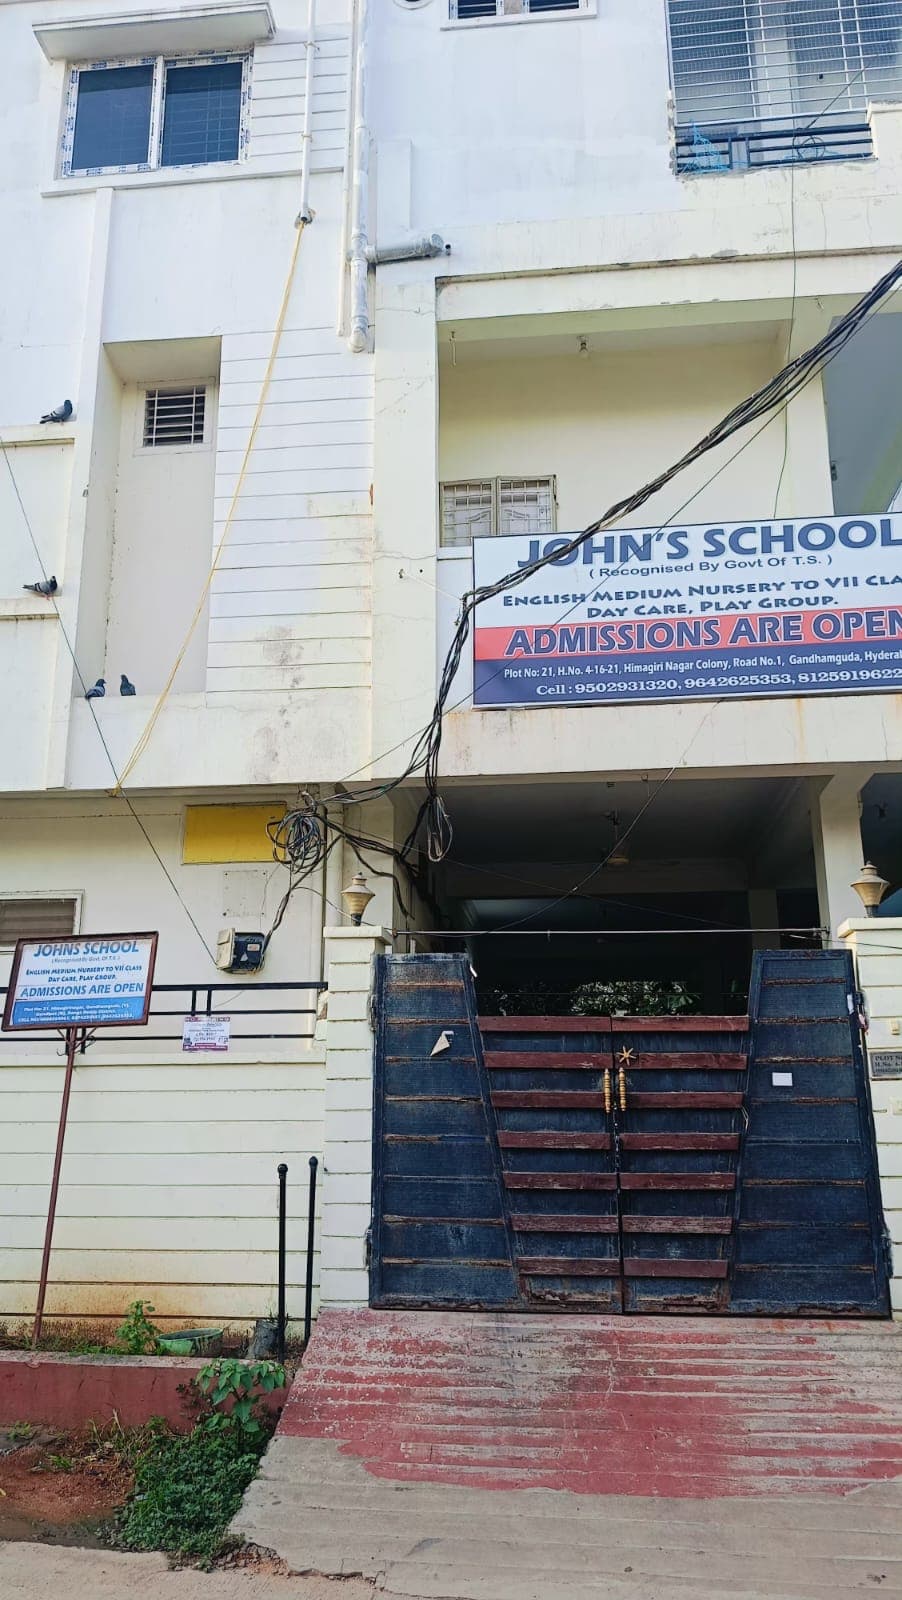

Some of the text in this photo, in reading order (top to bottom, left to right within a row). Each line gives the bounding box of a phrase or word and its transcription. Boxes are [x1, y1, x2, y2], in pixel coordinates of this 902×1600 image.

[518, 518, 902, 568] JOHN'S SCHOOL
[699, 561, 719, 572] By
[724, 558, 763, 569] Govt
[767, 556, 786, 566] Of
[503, 593, 586, 607] ENGLISH
[593, 588, 682, 601] MEDIUM
[688, 581, 786, 596] NURSERY
[790, 580, 819, 590] TO
[825, 576, 858, 588] VII
[587, 596, 839, 619] DAY CARE, PLAY GROUP.
[504, 617, 721, 657] ADMISSIONS
[728, 615, 803, 645] ARE
[504, 668, 522, 679] Plot
[524, 667, 540, 677] No:
[541, 666, 556, 678] 21,
[557, 665, 584, 676] H.No.
[585, 663, 622, 675] 4-16-21,
[624, 661, 664, 675] Himagiri
[665, 659, 695, 672] Nagar
[695, 658, 731, 671] Colony,
[733, 656, 758, 667] Road
[789, 651, 863, 666] Gandhamguda,
[864, 649, 902, 663] Hydera
[684, 673, 796, 689] 9642625353,
[33, 941, 139, 957] JOHNS SCHOOL
[20, 983, 144, 998] ADMISSIONS ARE OPEN
